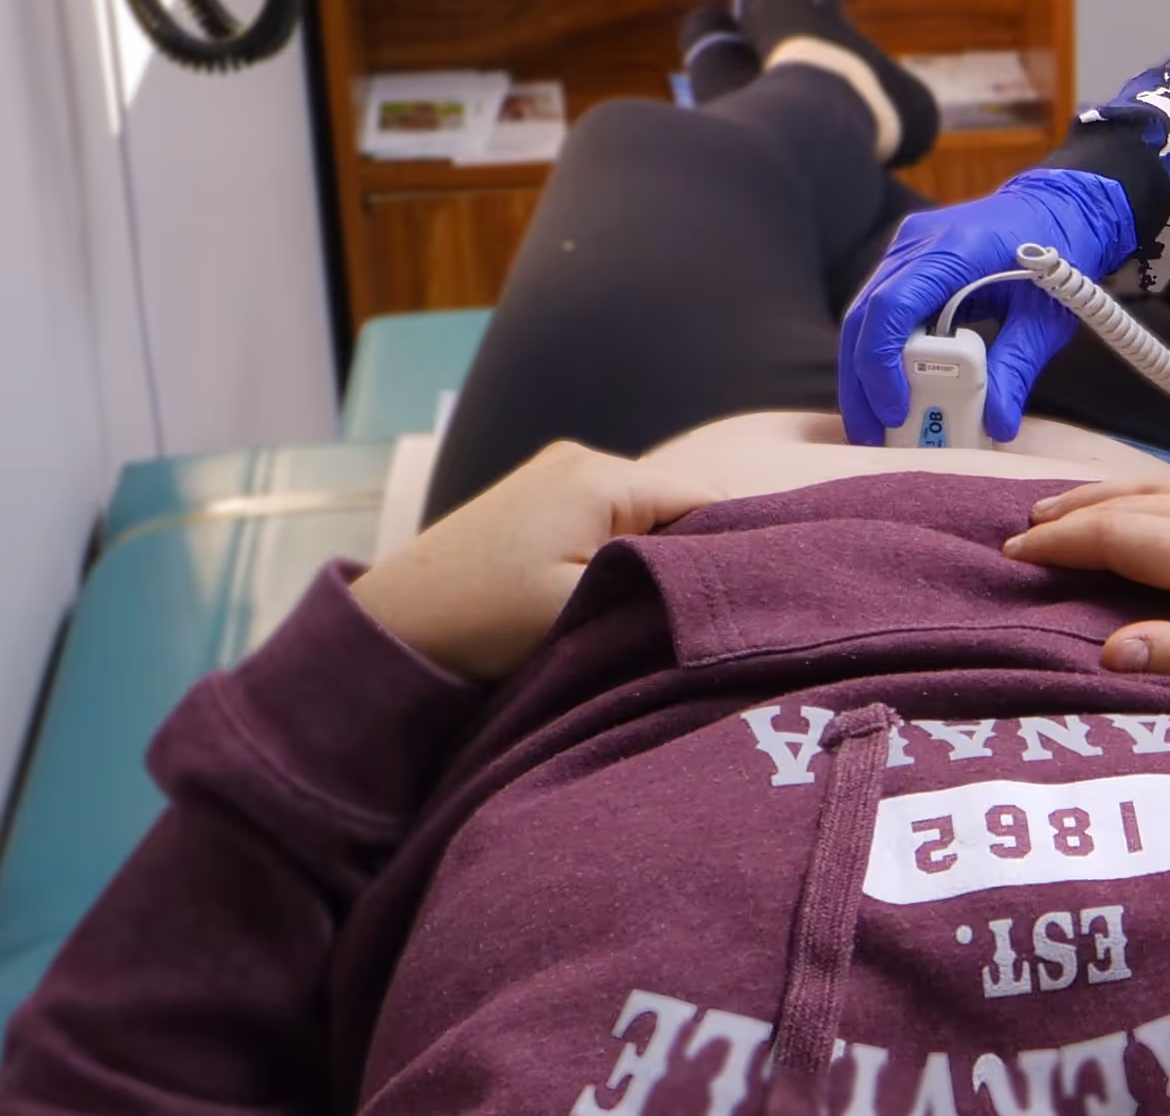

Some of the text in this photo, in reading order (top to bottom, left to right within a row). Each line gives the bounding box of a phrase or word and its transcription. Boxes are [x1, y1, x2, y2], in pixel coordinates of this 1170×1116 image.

[928, 411, 943, 434] OB
[911, 801, 1143, 875] 1862
[956, 905, 1133, 999] EST.
